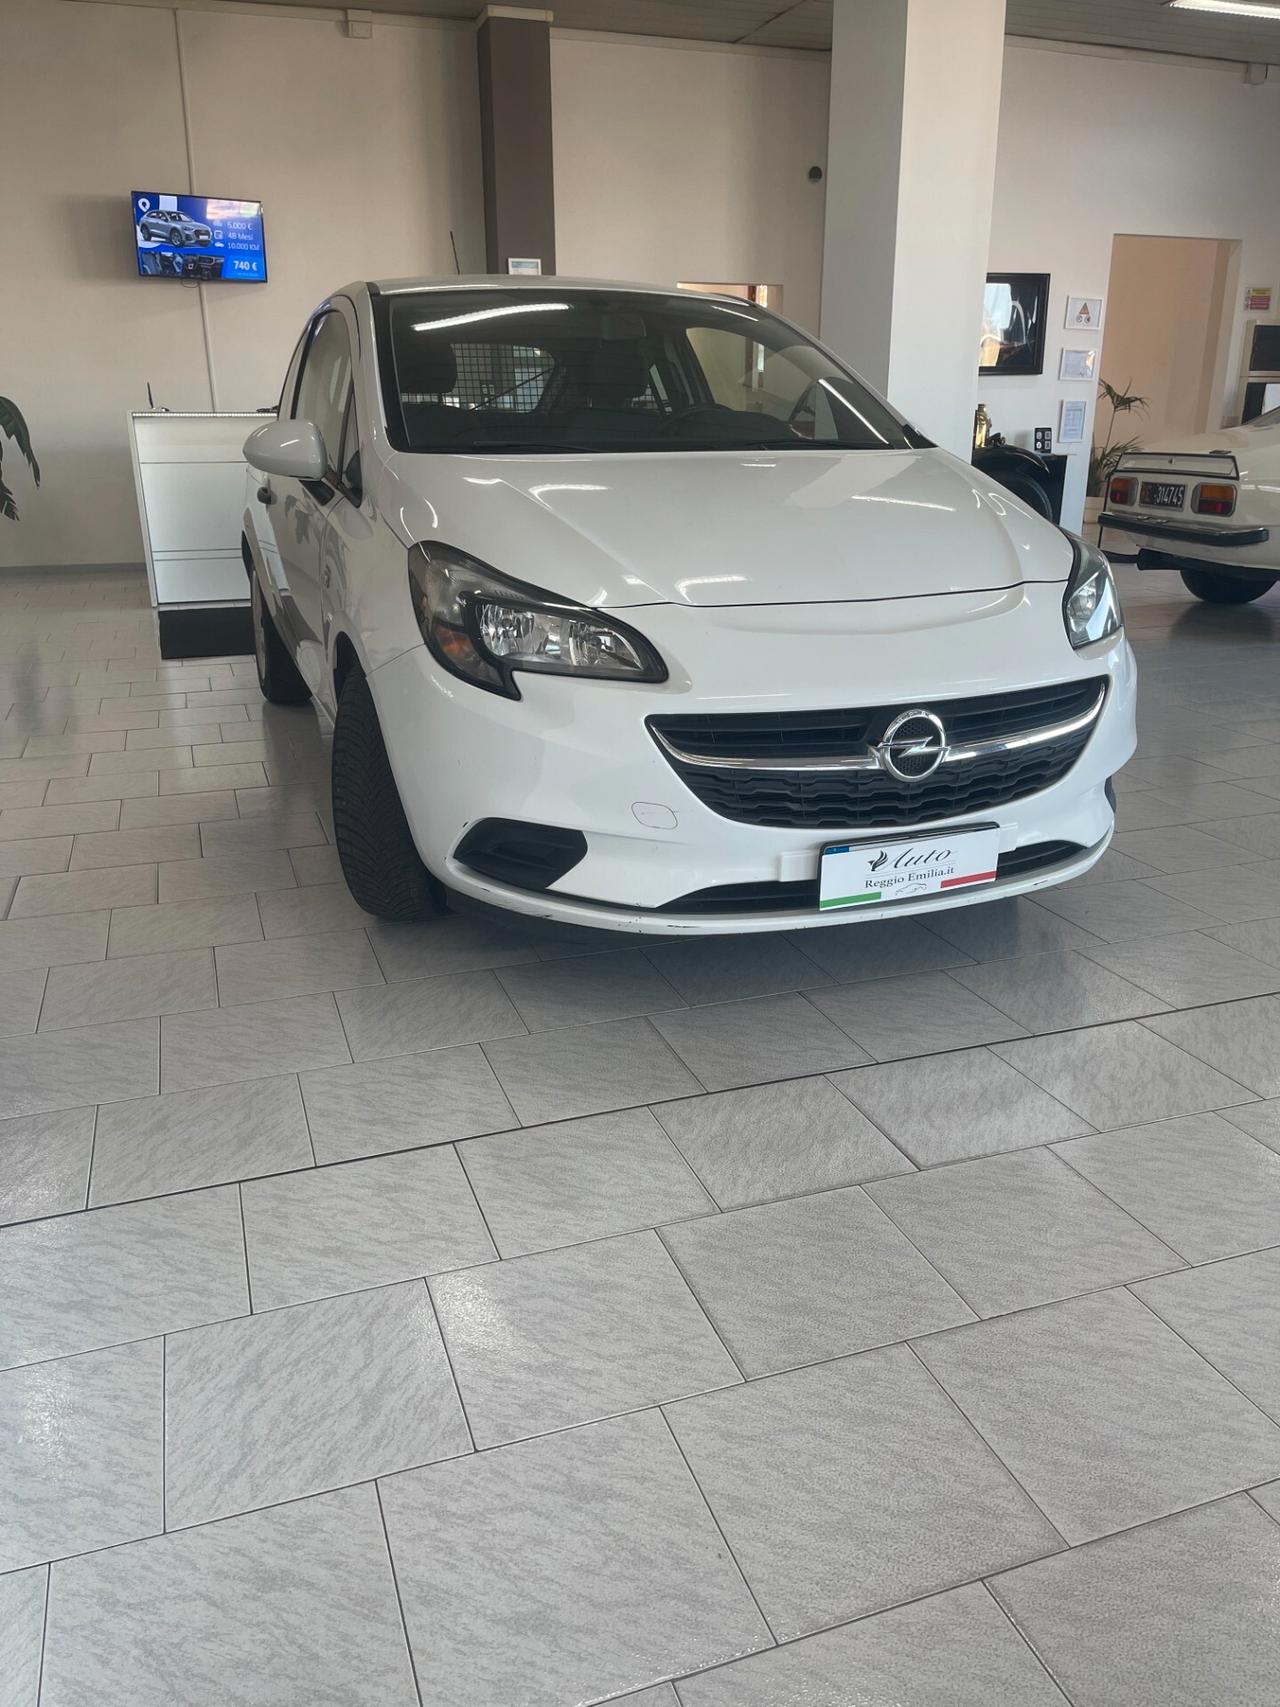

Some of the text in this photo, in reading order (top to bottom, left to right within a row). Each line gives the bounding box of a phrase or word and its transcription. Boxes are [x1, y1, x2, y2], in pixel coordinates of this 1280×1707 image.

[233, 260, 257, 271] 740 €
[865, 866, 955, 888] Reggio Emilia.it
